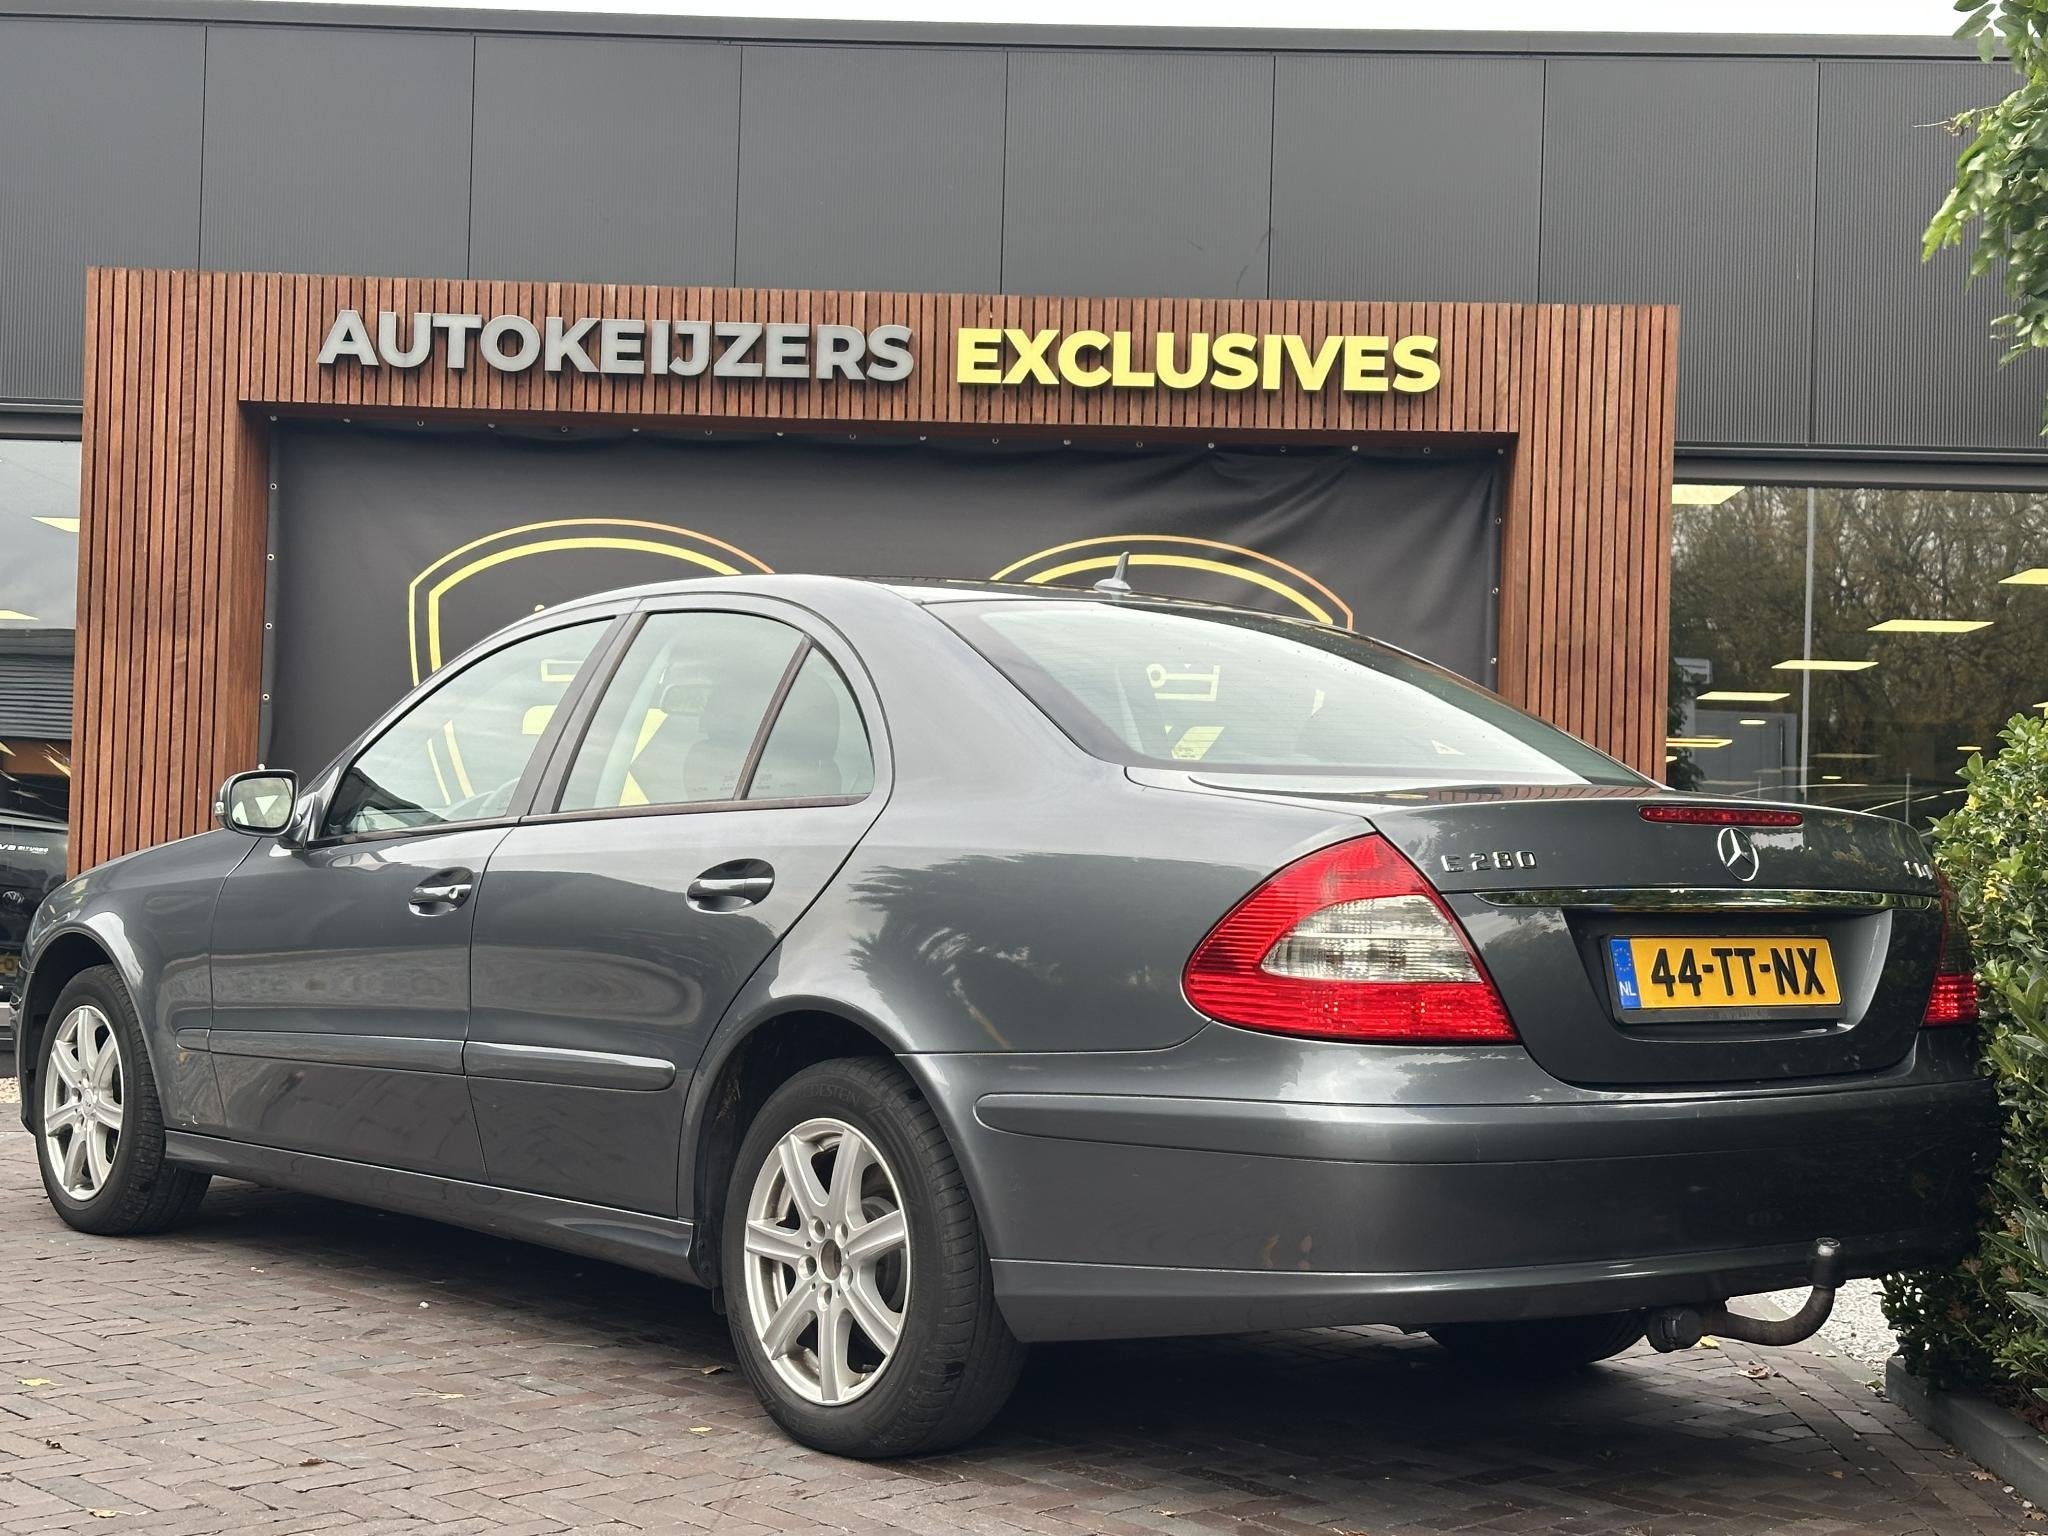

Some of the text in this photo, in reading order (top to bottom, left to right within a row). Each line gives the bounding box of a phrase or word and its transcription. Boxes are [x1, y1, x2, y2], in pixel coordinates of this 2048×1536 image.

[316, 309, 1442, 395] AUTOKEIJZERS EXCLUSIVES
[1441, 850, 1537, 873] E 280
[1618, 981, 1637, 997] NL
[1650, 947, 1826, 997] 44-TT-NX
